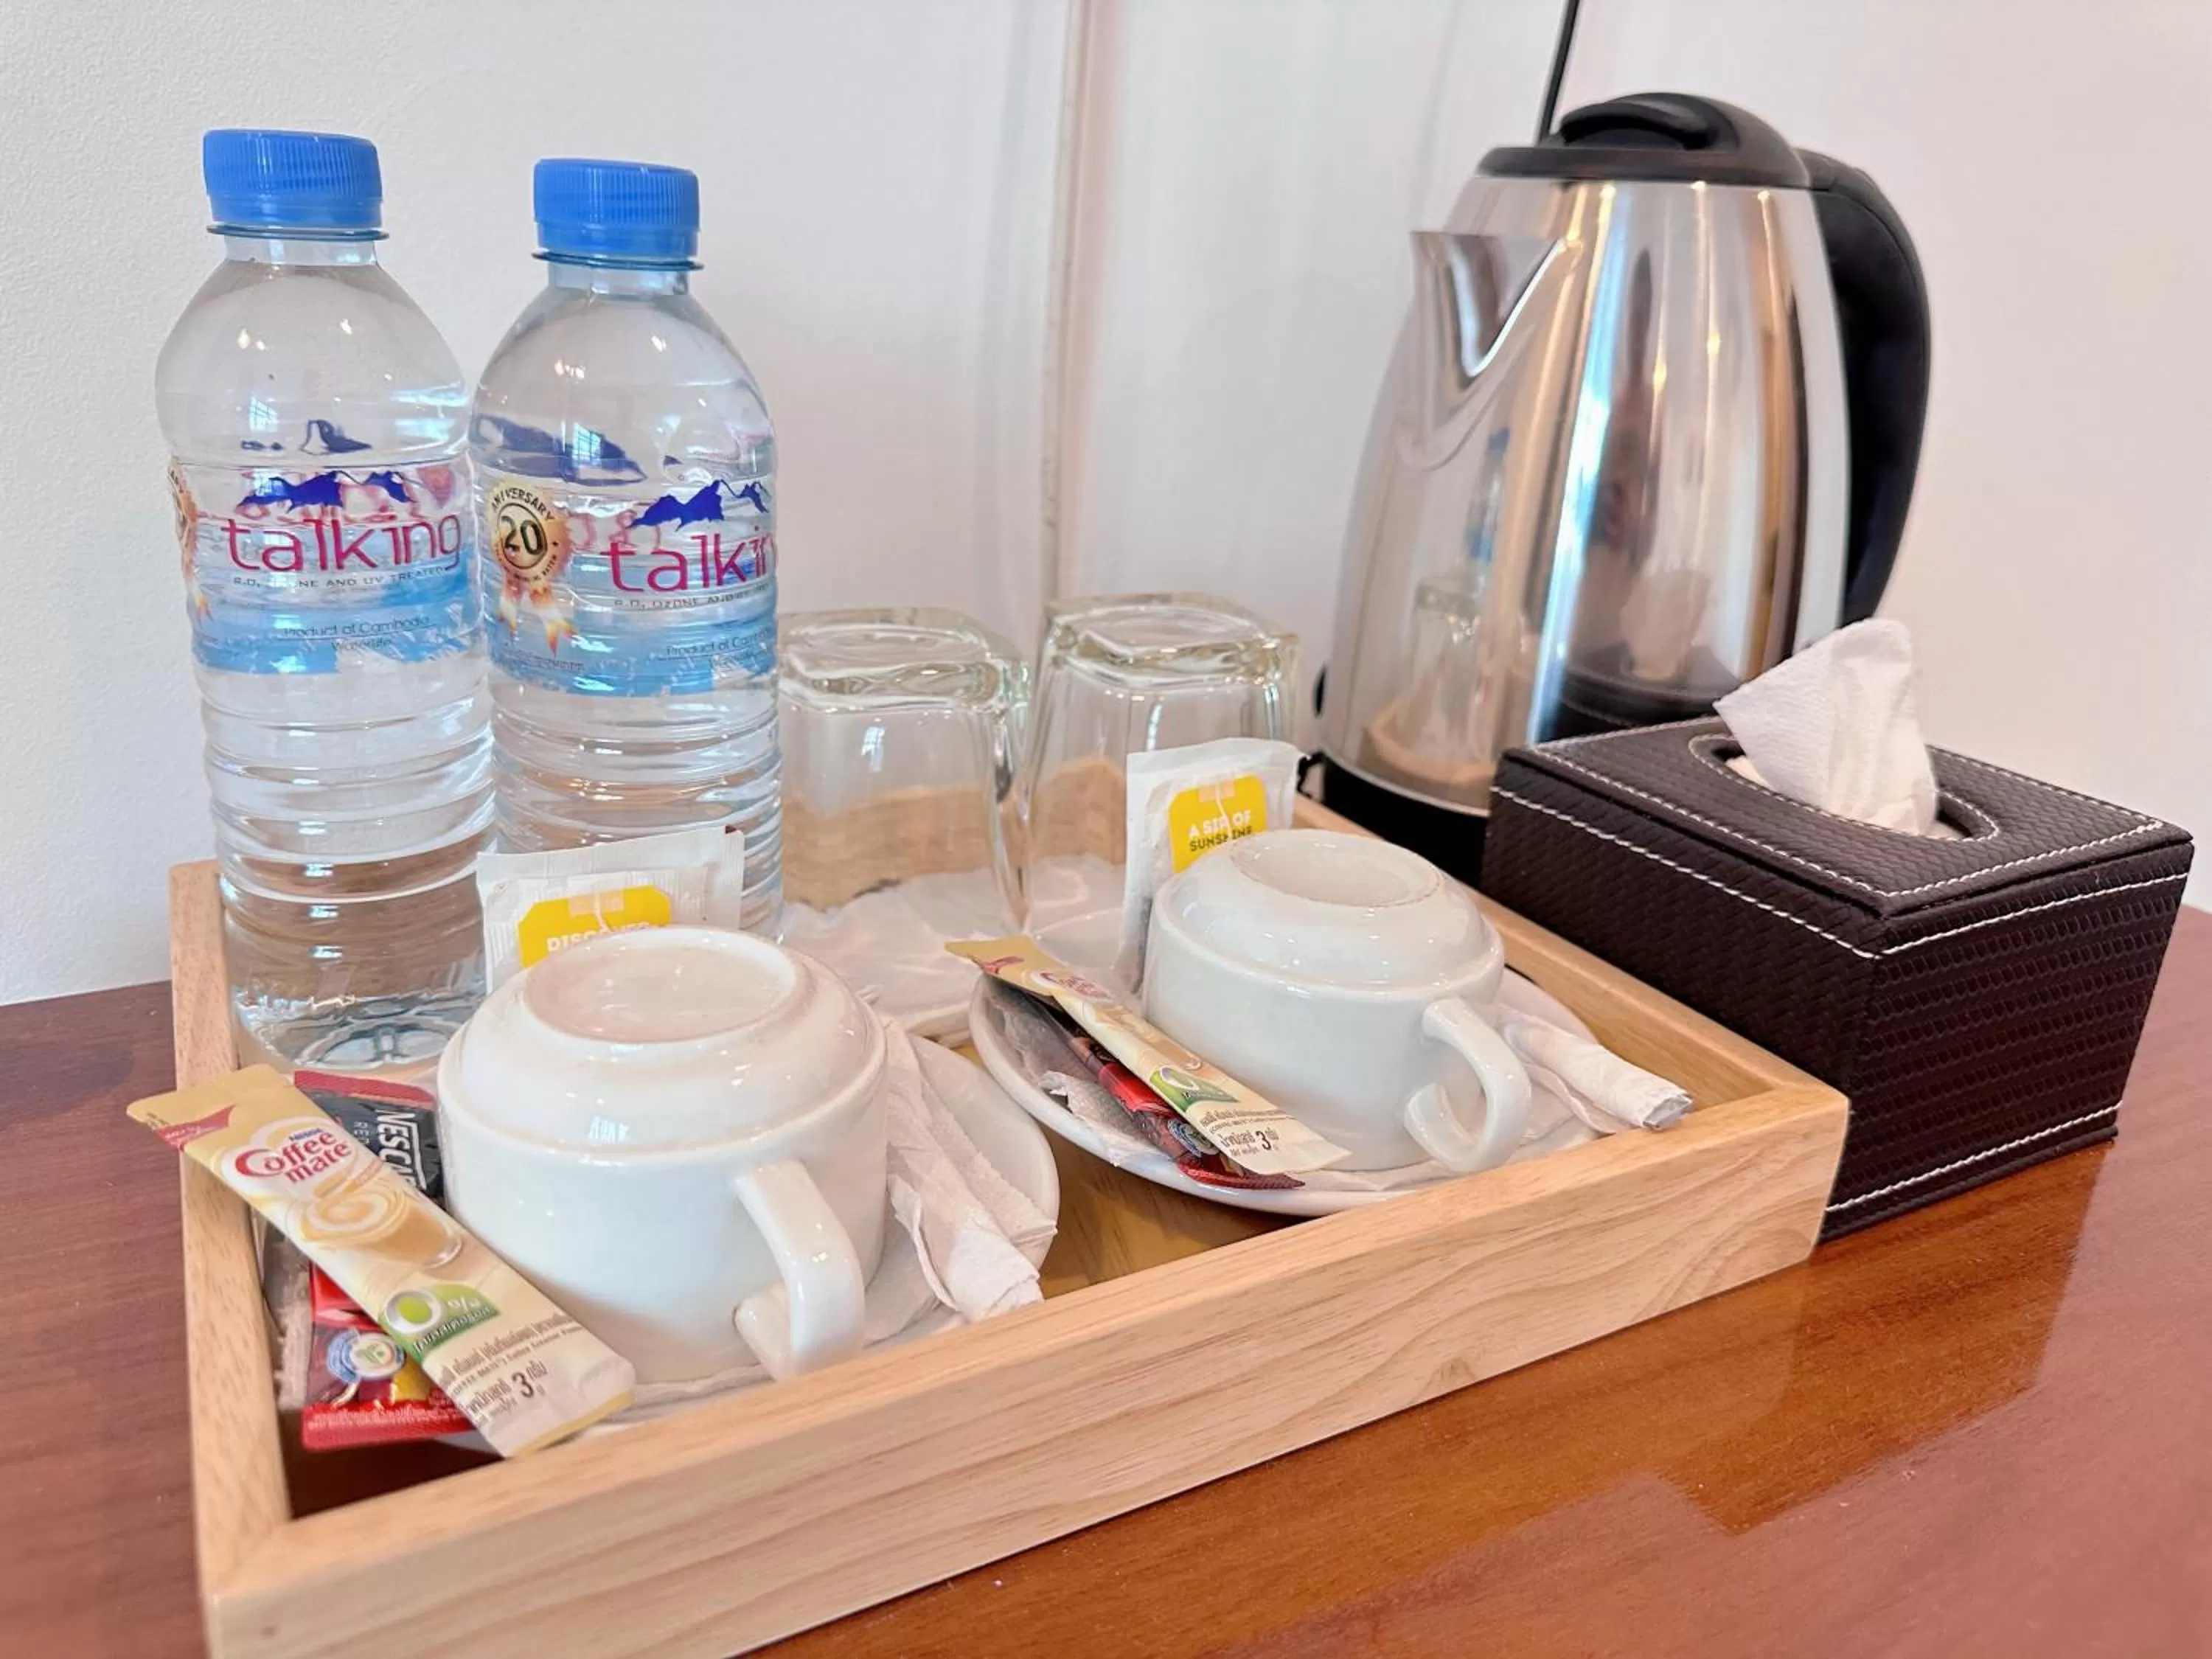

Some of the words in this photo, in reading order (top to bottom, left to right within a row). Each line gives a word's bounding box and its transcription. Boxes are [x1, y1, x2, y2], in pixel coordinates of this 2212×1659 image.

[220, 514, 462, 571] talking
[500, 515, 545, 555] 20
[326, 577, 358, 588] AND
[363, 575, 384, 585] UV
[1189, 823, 1200, 839] A
[1233, 810, 1251, 825] OF
[235, 1132, 337, 1177] Coffee
[1256, 1130, 1272, 1151] 3
[285, 1143, 352, 1183] mate
[512, 1371, 534, 1398] 3
